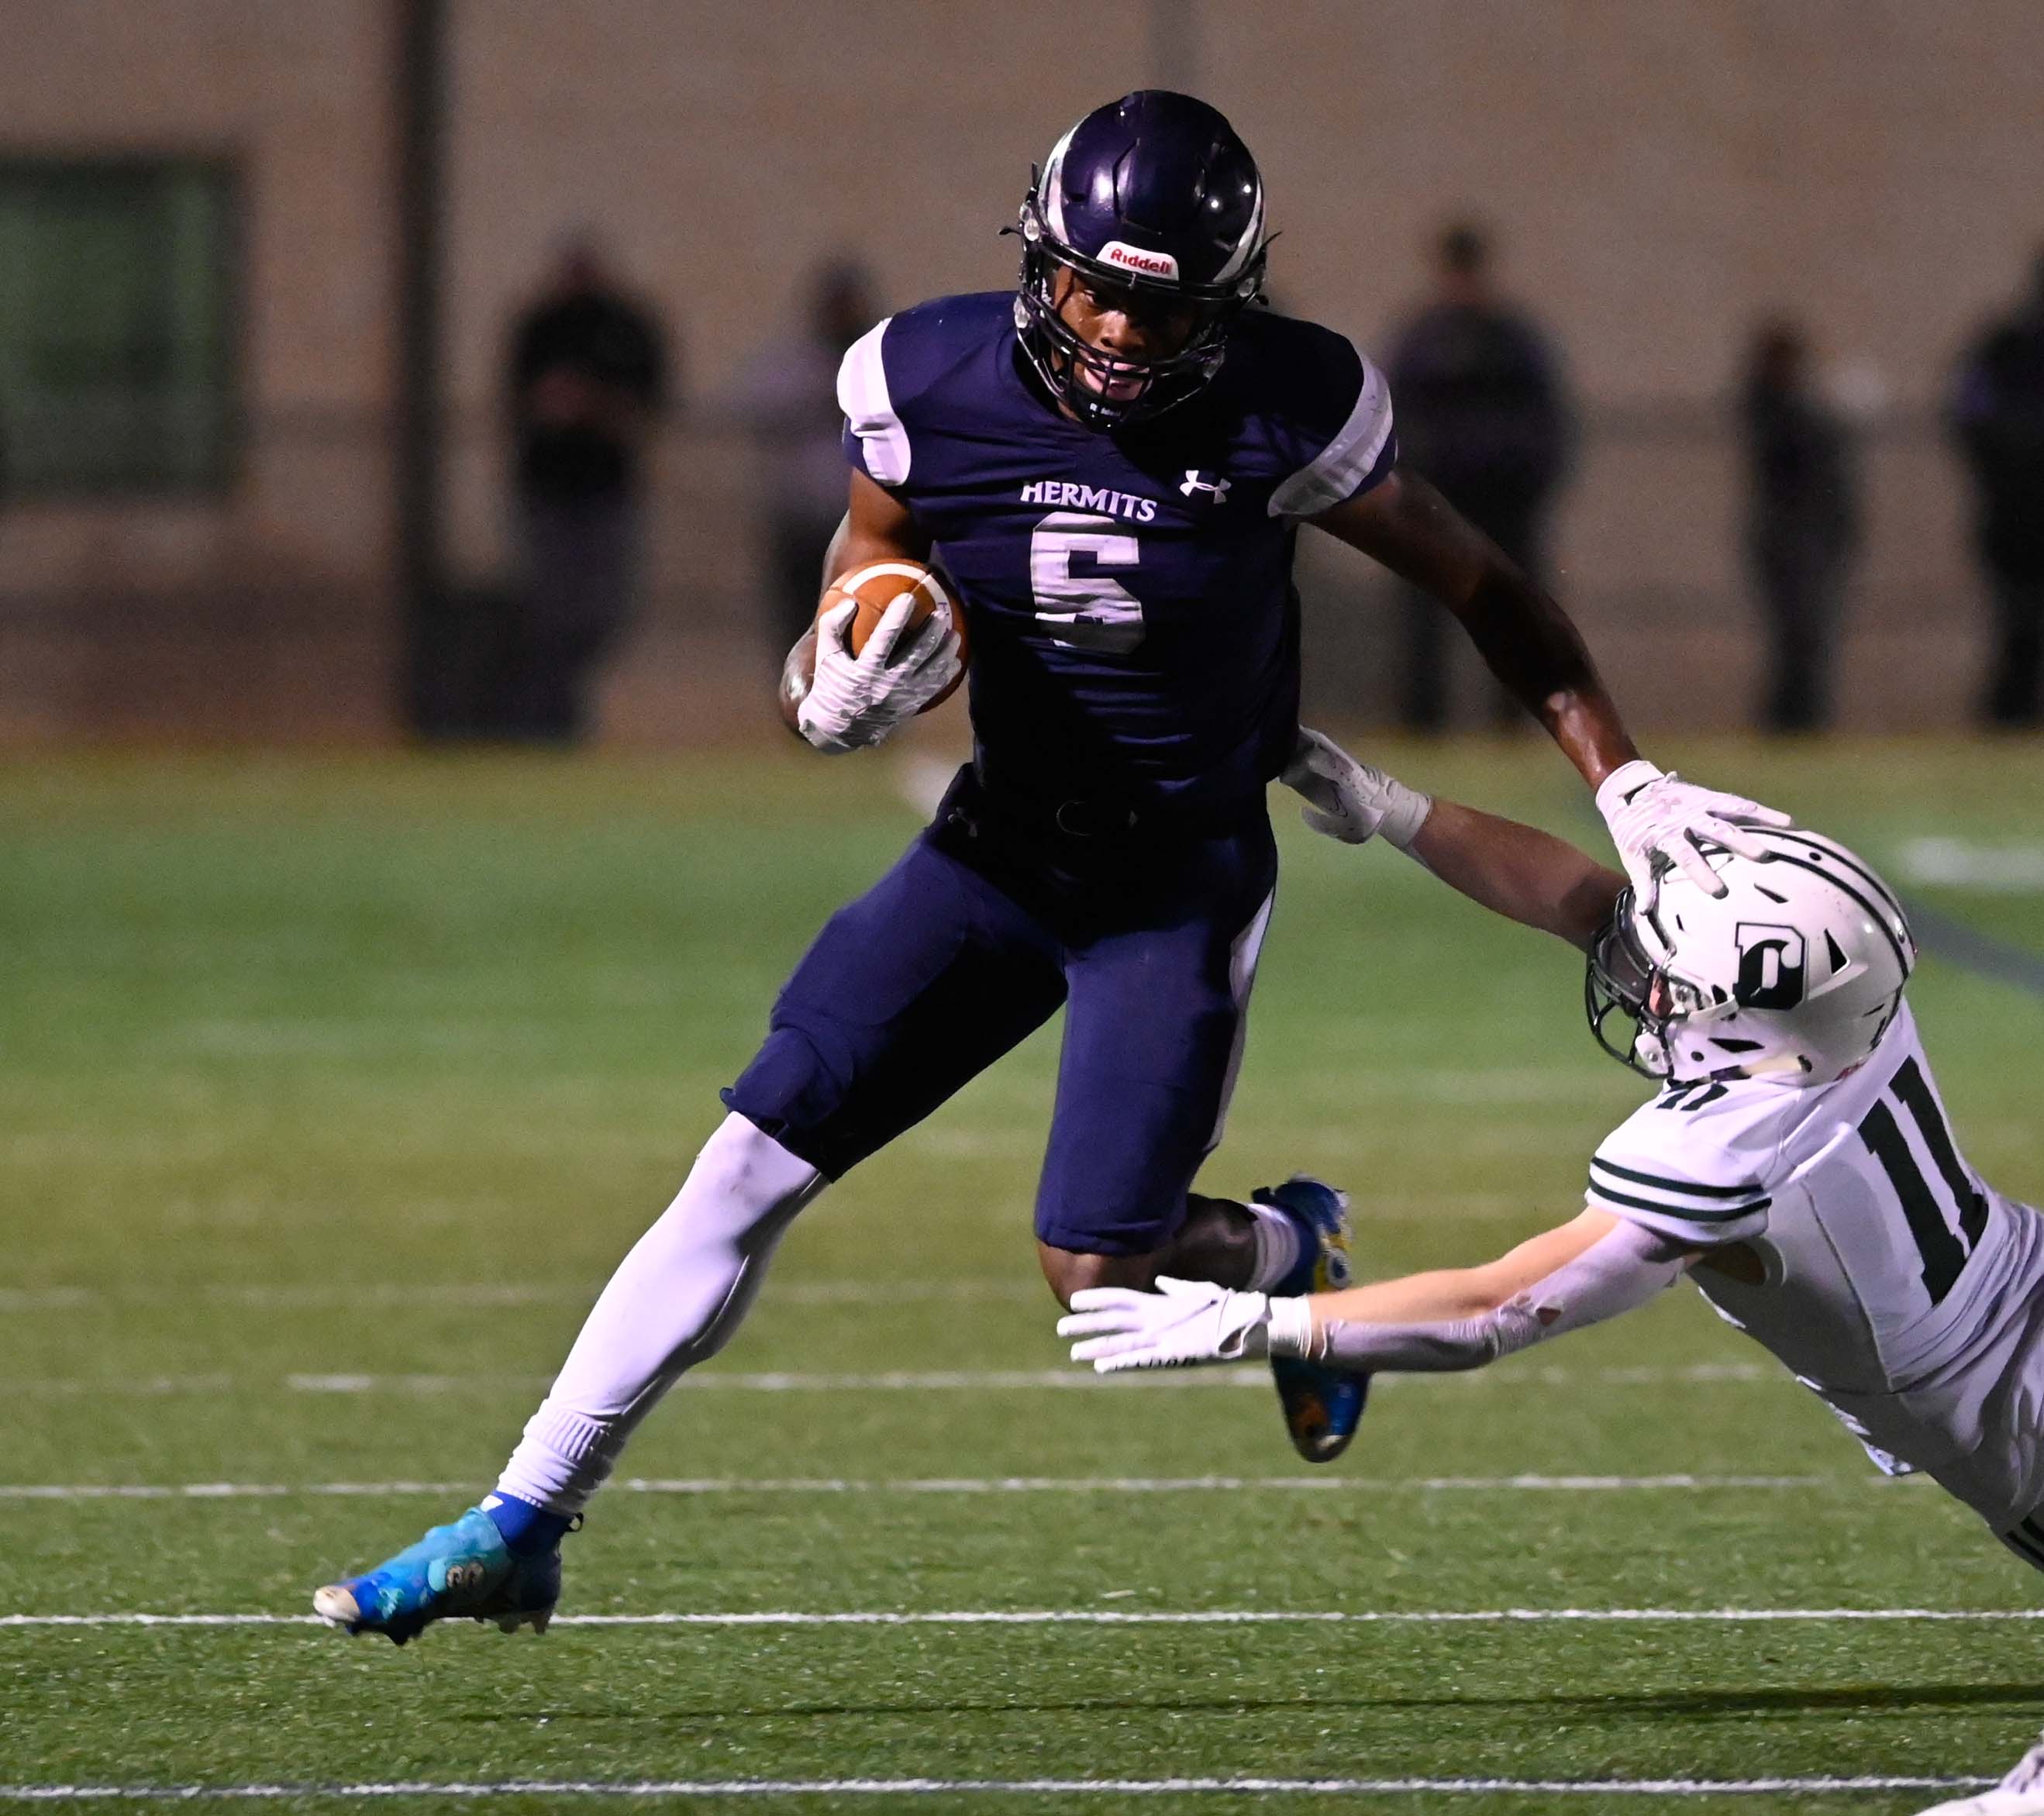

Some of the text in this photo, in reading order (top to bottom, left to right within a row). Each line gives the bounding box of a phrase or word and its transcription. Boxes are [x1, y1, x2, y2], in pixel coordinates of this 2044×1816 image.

[1110, 248, 1173, 275] Riddell
[1019, 480, 1158, 522] HERMITS
[1856, 1054, 1990, 1308] 11
